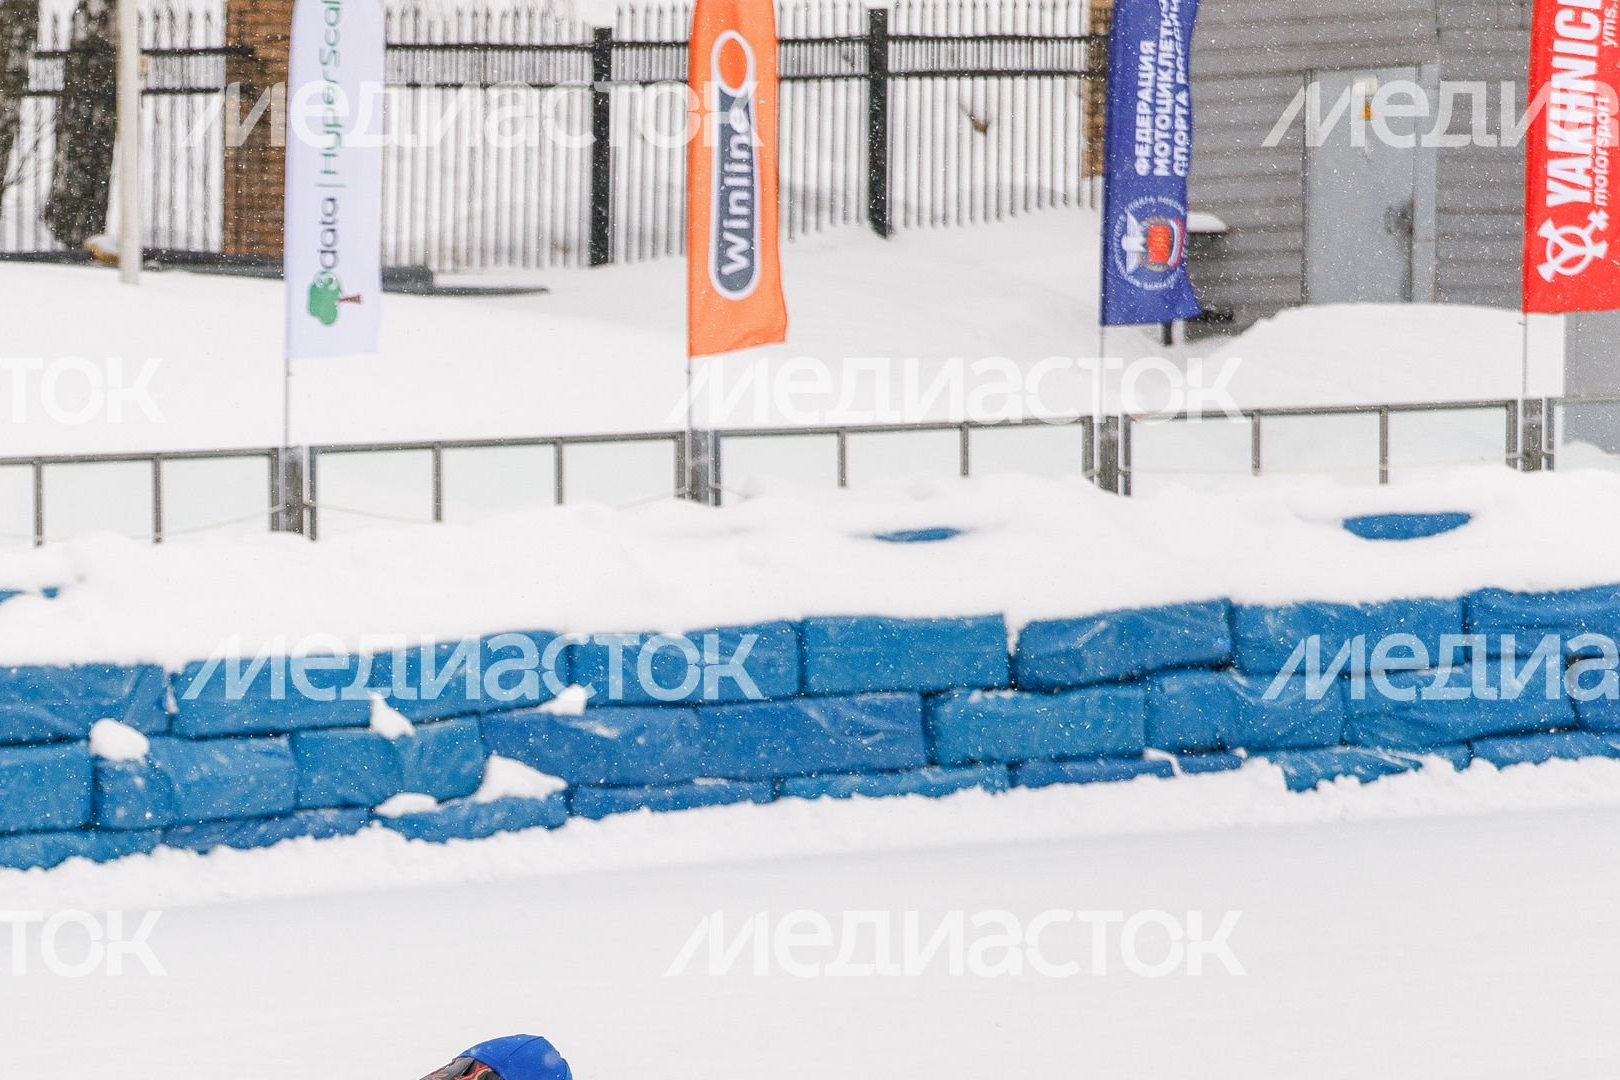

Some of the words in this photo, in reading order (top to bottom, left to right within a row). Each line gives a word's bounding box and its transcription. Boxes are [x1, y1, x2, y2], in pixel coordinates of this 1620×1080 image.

[1134, 41, 1156, 175] ФЕДЕРАЦИЯ
[1591, 96, 1611, 207] motorsport
[720, 106, 751, 276] Winline
